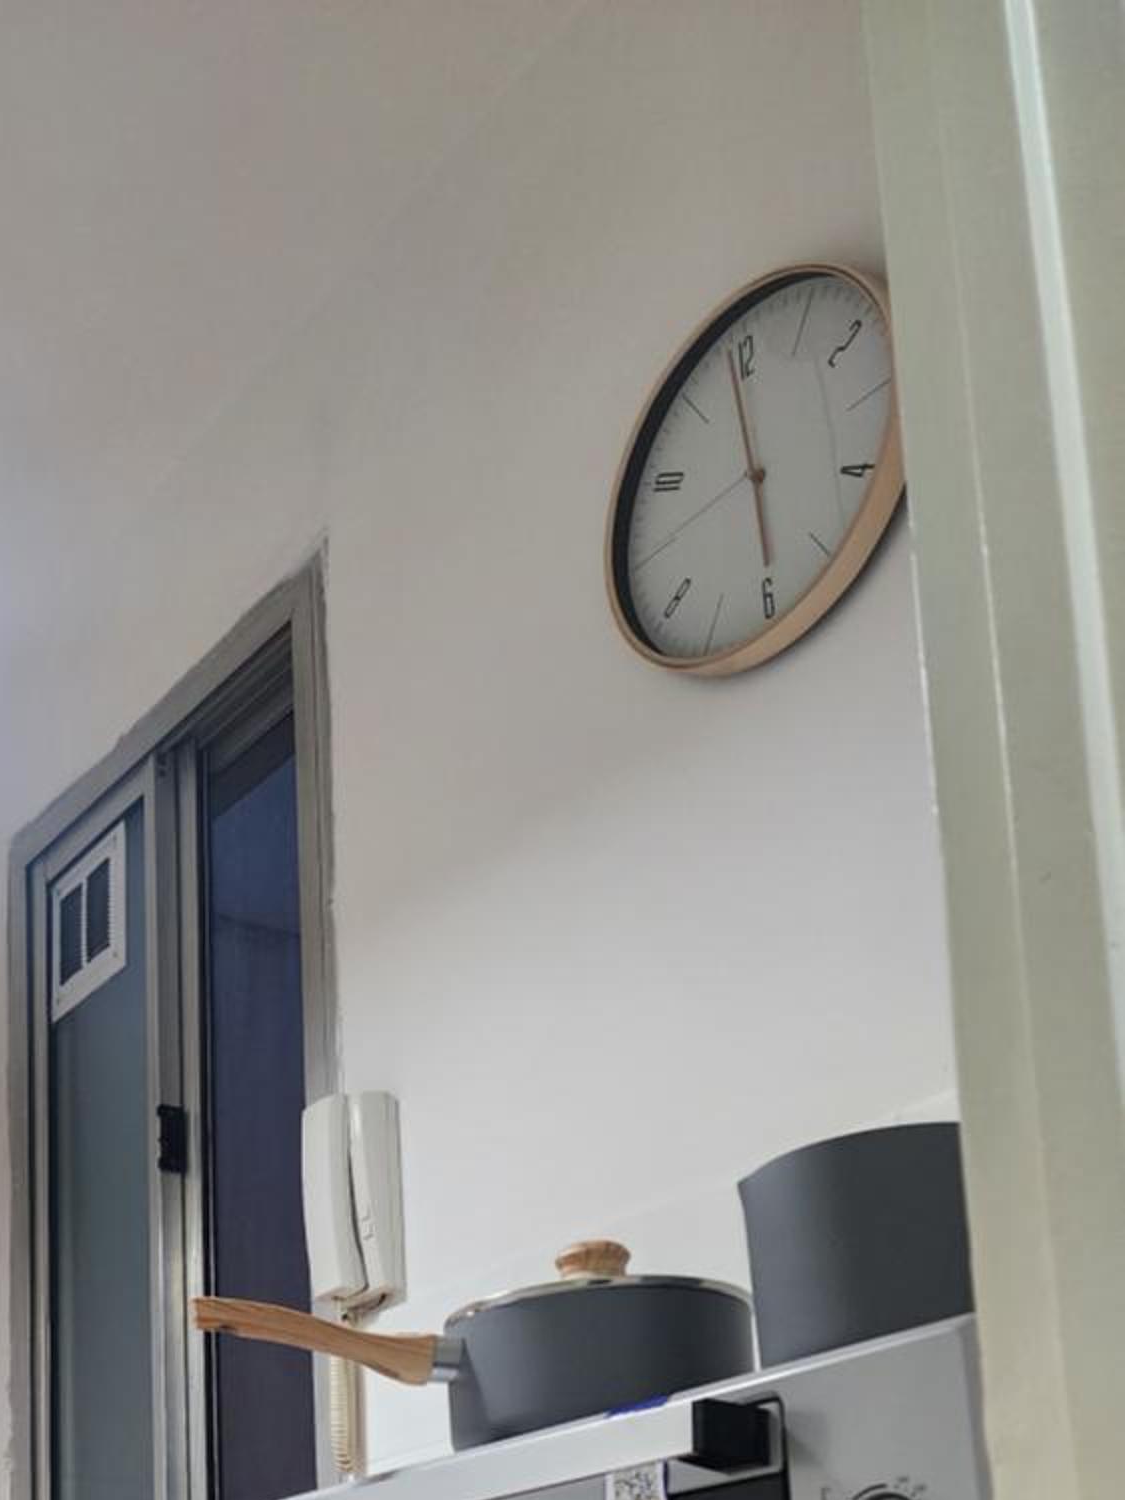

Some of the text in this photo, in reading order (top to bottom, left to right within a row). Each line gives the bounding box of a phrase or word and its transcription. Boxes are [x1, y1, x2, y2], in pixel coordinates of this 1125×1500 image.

[737, 335, 755, 379] 12
[827, 319, 862, 369] 2
[840, 462, 875, 478] 4
[761, 577, 776, 619] 6
